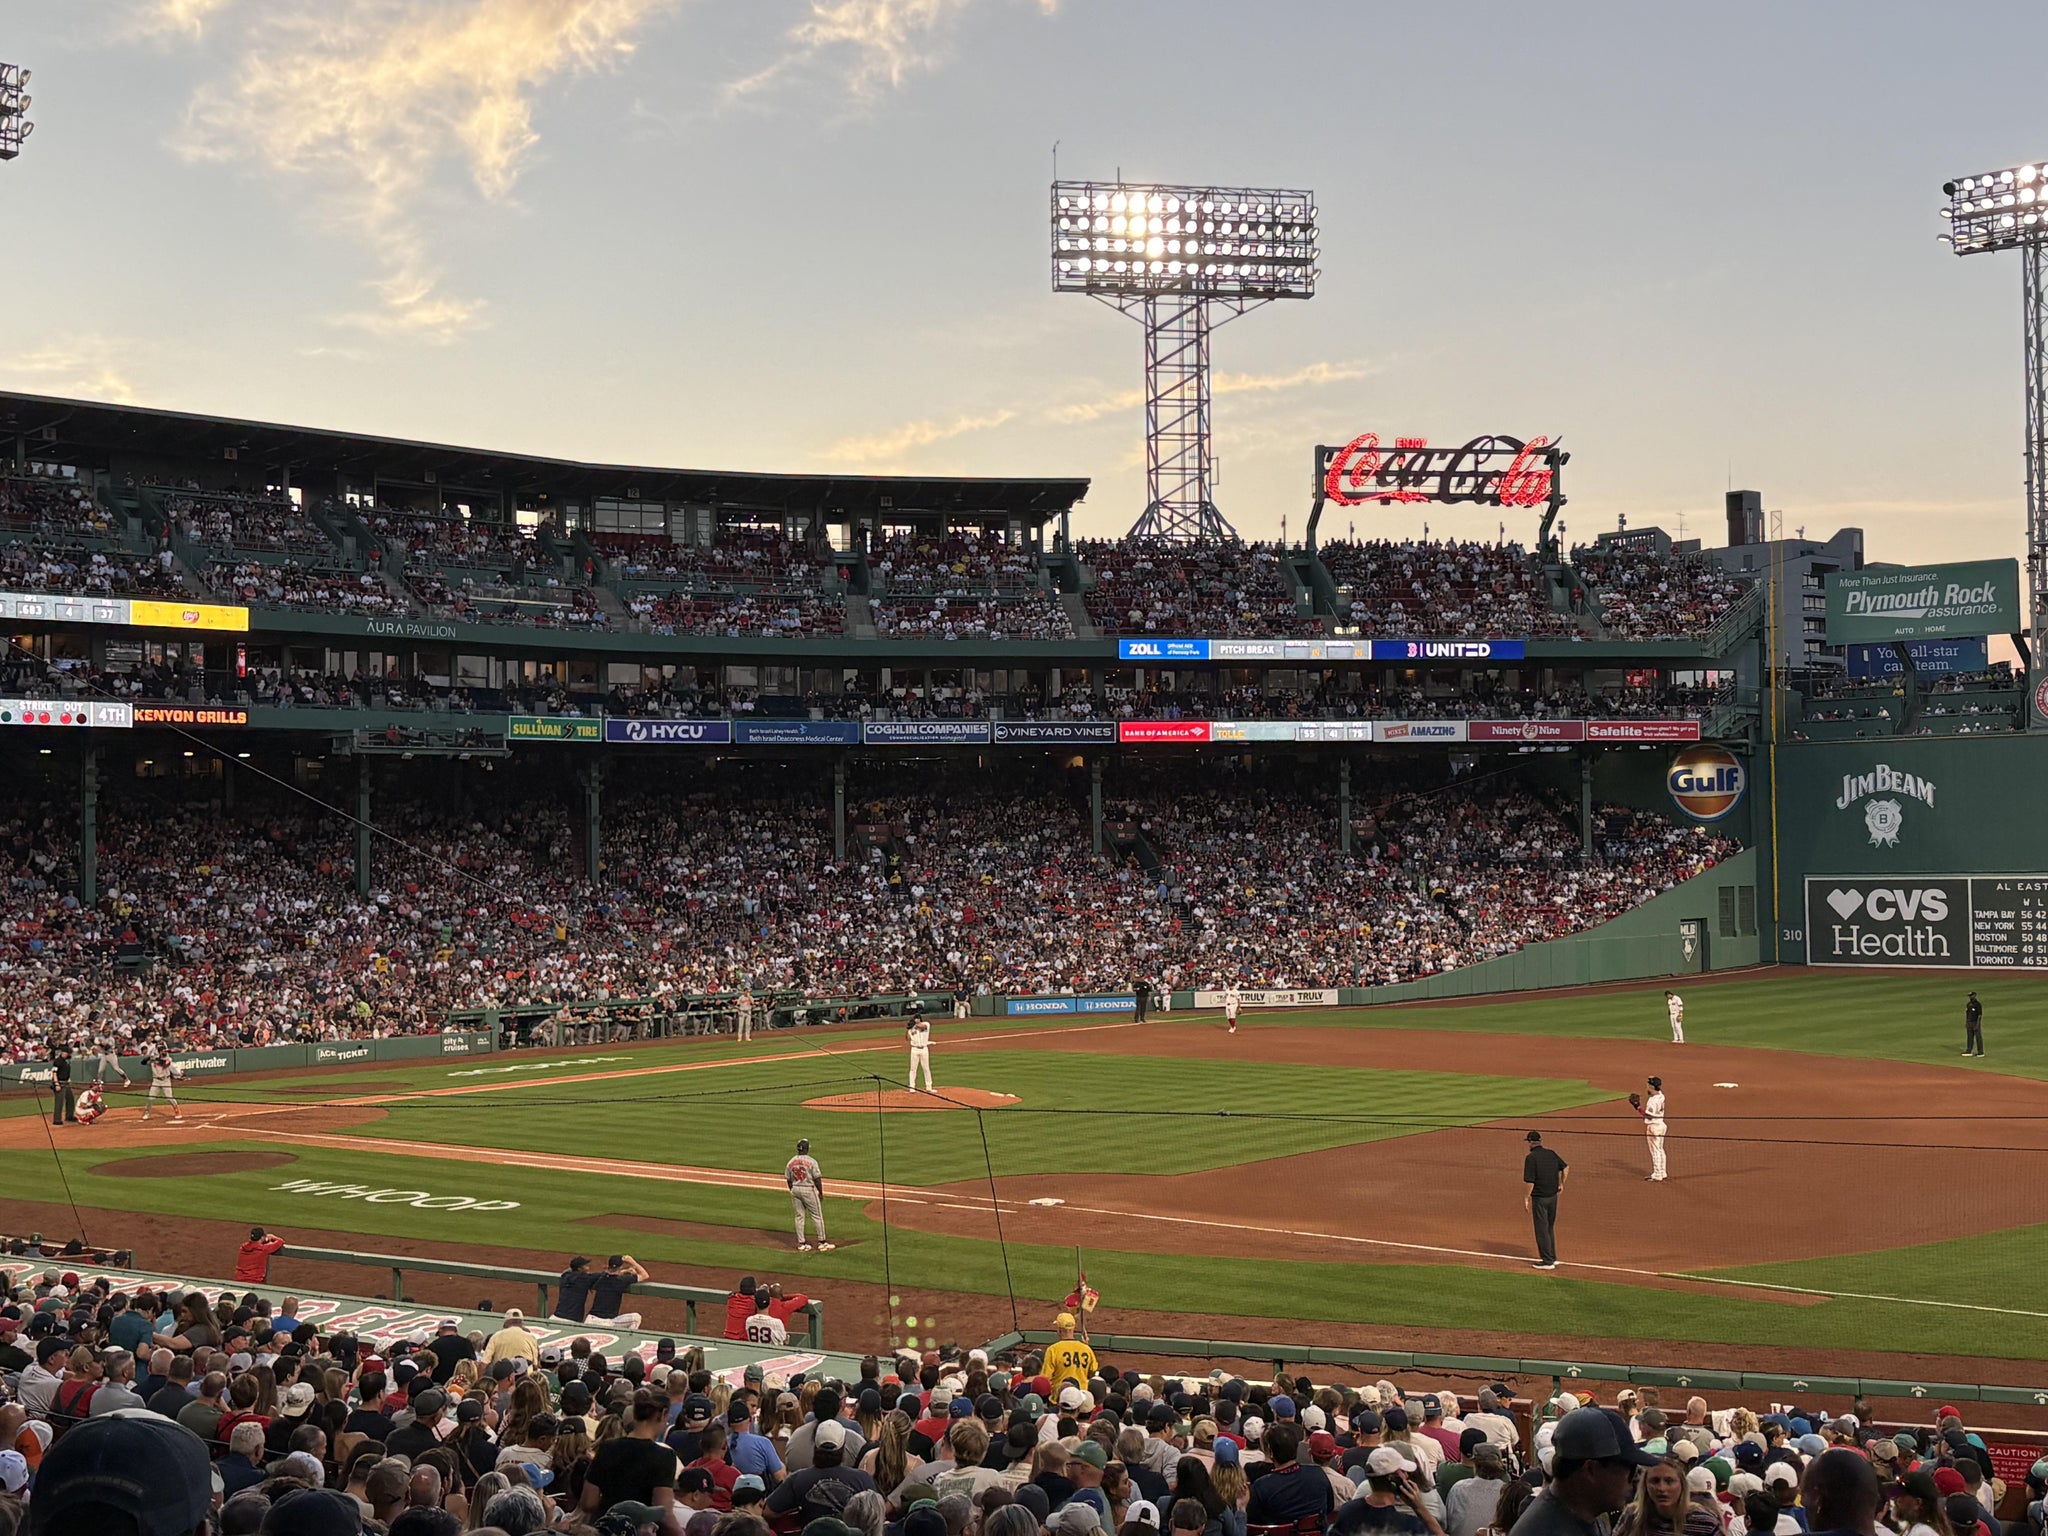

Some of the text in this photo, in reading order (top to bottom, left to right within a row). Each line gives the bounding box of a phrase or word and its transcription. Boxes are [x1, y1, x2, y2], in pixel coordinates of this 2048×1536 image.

[1396, 437, 1427, 450] ENJOY
[1839, 573, 1939, 588] More Than Just Insurance.
[1845, 581, 1996, 615] Plymouth Rock
[66, 607, 72, 617] 4
[101, 610, 113, 619] 37
[1928, 603, 1997, 618] assurance
[366, 621, 456, 638] AURA PAVILION
[1895, 627, 1914, 635] AUTO
[1925, 625, 1946, 633] HOME
[1129, 643, 1161, 655] ZOLL
[1220, 645, 1275, 655] PITCH BREAK
[1426, 643, 1490, 657] UNITED
[1910, 645, 1959, 658] all-star
[1915, 660, 1953, 671] team.
[19, 701, 53, 711] STRIKE
[64, 704, 83, 712] OUT
[98, 711, 125, 723] 4TH
[135, 709, 247, 725] KENYON GRILLS
[513, 721, 597, 737] SULLIVAN TIRE
[652, 725, 704, 738] HYCU
[866, 725, 988, 734] COGHLIN COMPANIES
[1009, 728, 1112, 737] VINEYARD VINES
[1410, 726, 1456, 737] AMAZING
[1491, 726, 1521, 737] Ninety
[1538, 726, 1560, 735] Nine
[1589, 727, 1642, 737] Safelite
[1671, 768, 1739, 792] Gulf
[1879, 814, 1888, 824] B
[1996, 883, 2048, 891] AL EAST
[1866, 888, 1949, 922] CVS
[2023, 898, 2044, 906] W L
[1974, 910, 2047, 920] TAMPA BAY 56 42
[1974, 922, 2047, 932] NEW YORK 55 44
[1783, 929, 1803, 941] 310
[1974, 933, 2047, 943] BOSTON 50 48
[1832, 925, 1950, 957] Health
[1975, 945, 2047, 955] BALTIMORE 49 51
[1975, 956, 2048, 966] TORONTO 46 53
[1240, 993, 1265, 1002] TRULY
[1297, 992, 1323, 1001] TRULY
[1025, 1002, 1068, 1010] HONDA
[443, 1038, 456, 1046] city
[319, 1049, 368, 1060] ACE TICKET
[268, 1179, 521, 1211] WHOOP
[748, 1326, 772, 1343] 83
[1062, 1352, 1089, 1368] 343
[1031, 1402, 1037, 1411] B
[1988, 1447, 2041, 1458] CAUTION!
[1706, 1480, 1712, 1490] B
